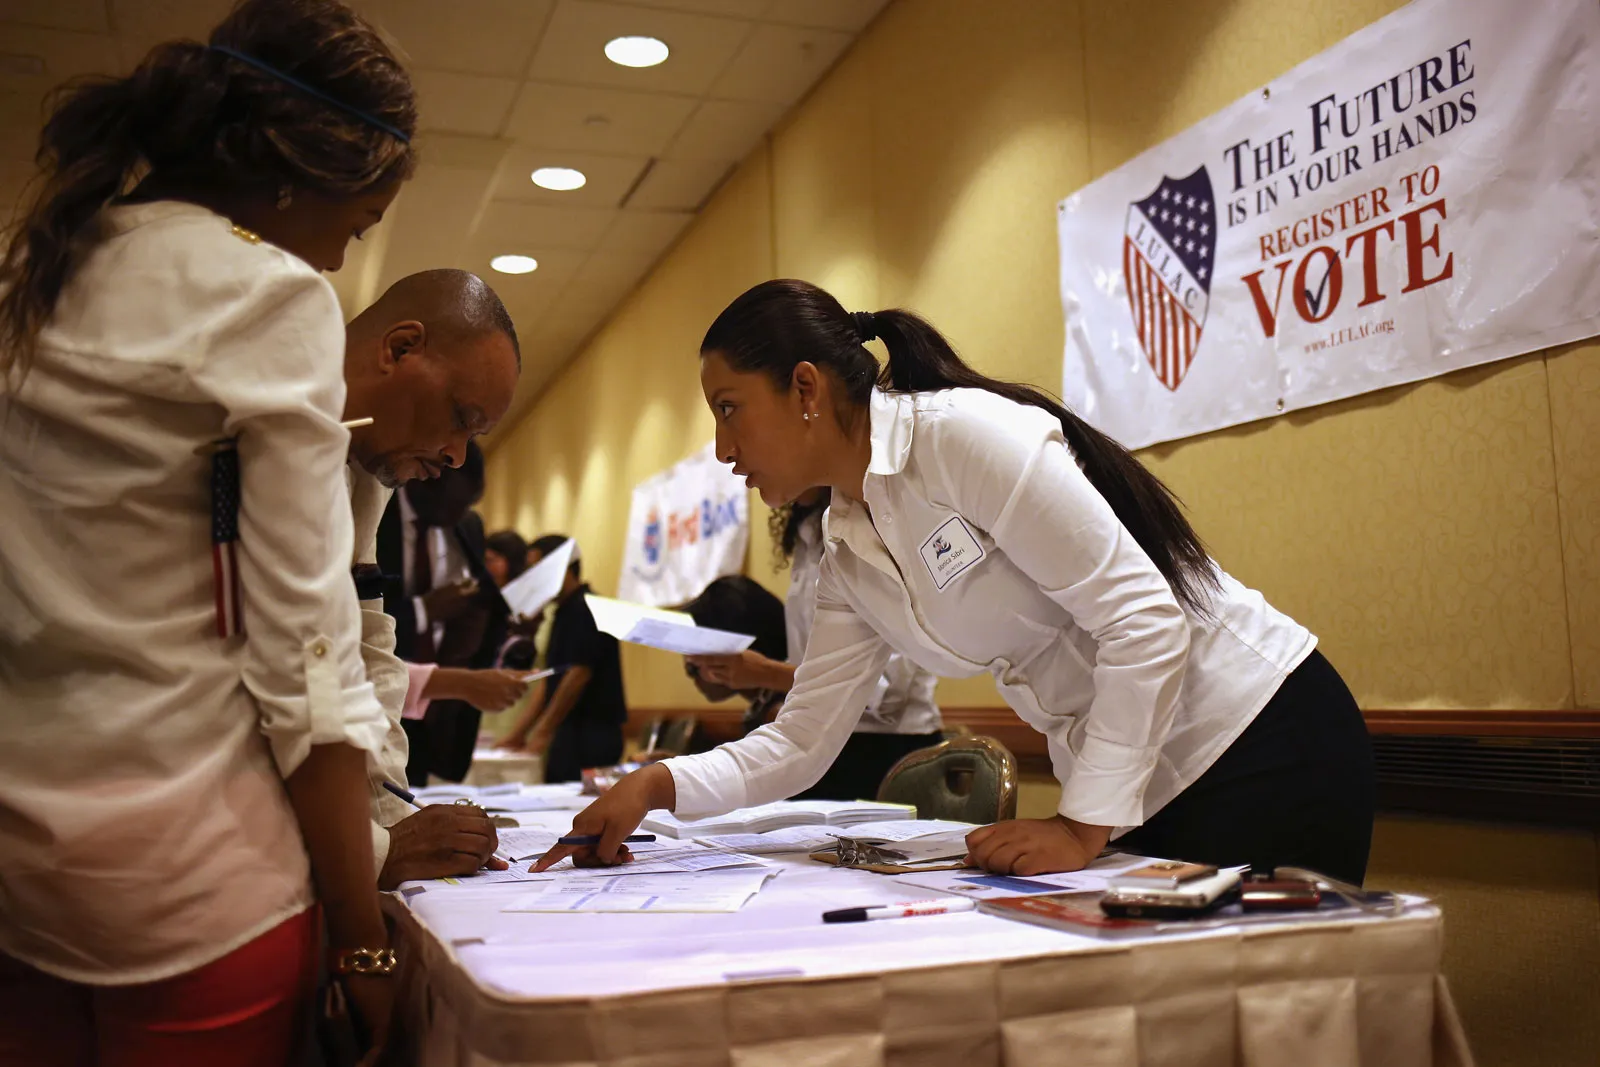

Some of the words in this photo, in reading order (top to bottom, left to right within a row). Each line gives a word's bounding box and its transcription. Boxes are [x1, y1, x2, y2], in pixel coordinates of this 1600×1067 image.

[1223, 129, 1297, 193] THE
[1307, 38, 1475, 156] FUTURE
[1226, 197, 1247, 229] IS
[1256, 180, 1279, 216] IN
[1288, 144, 1363, 200] YOUR
[1372, 91, 1477, 163] HANDS
[1135, 222, 1199, 310] LULAC
[1240, 198, 1454, 339] VOTE
[1259, 186, 1392, 262] REGISTER
[1399, 164, 1441, 205] TO
[1304, 316, 1395, 355] www.LULAC.org
